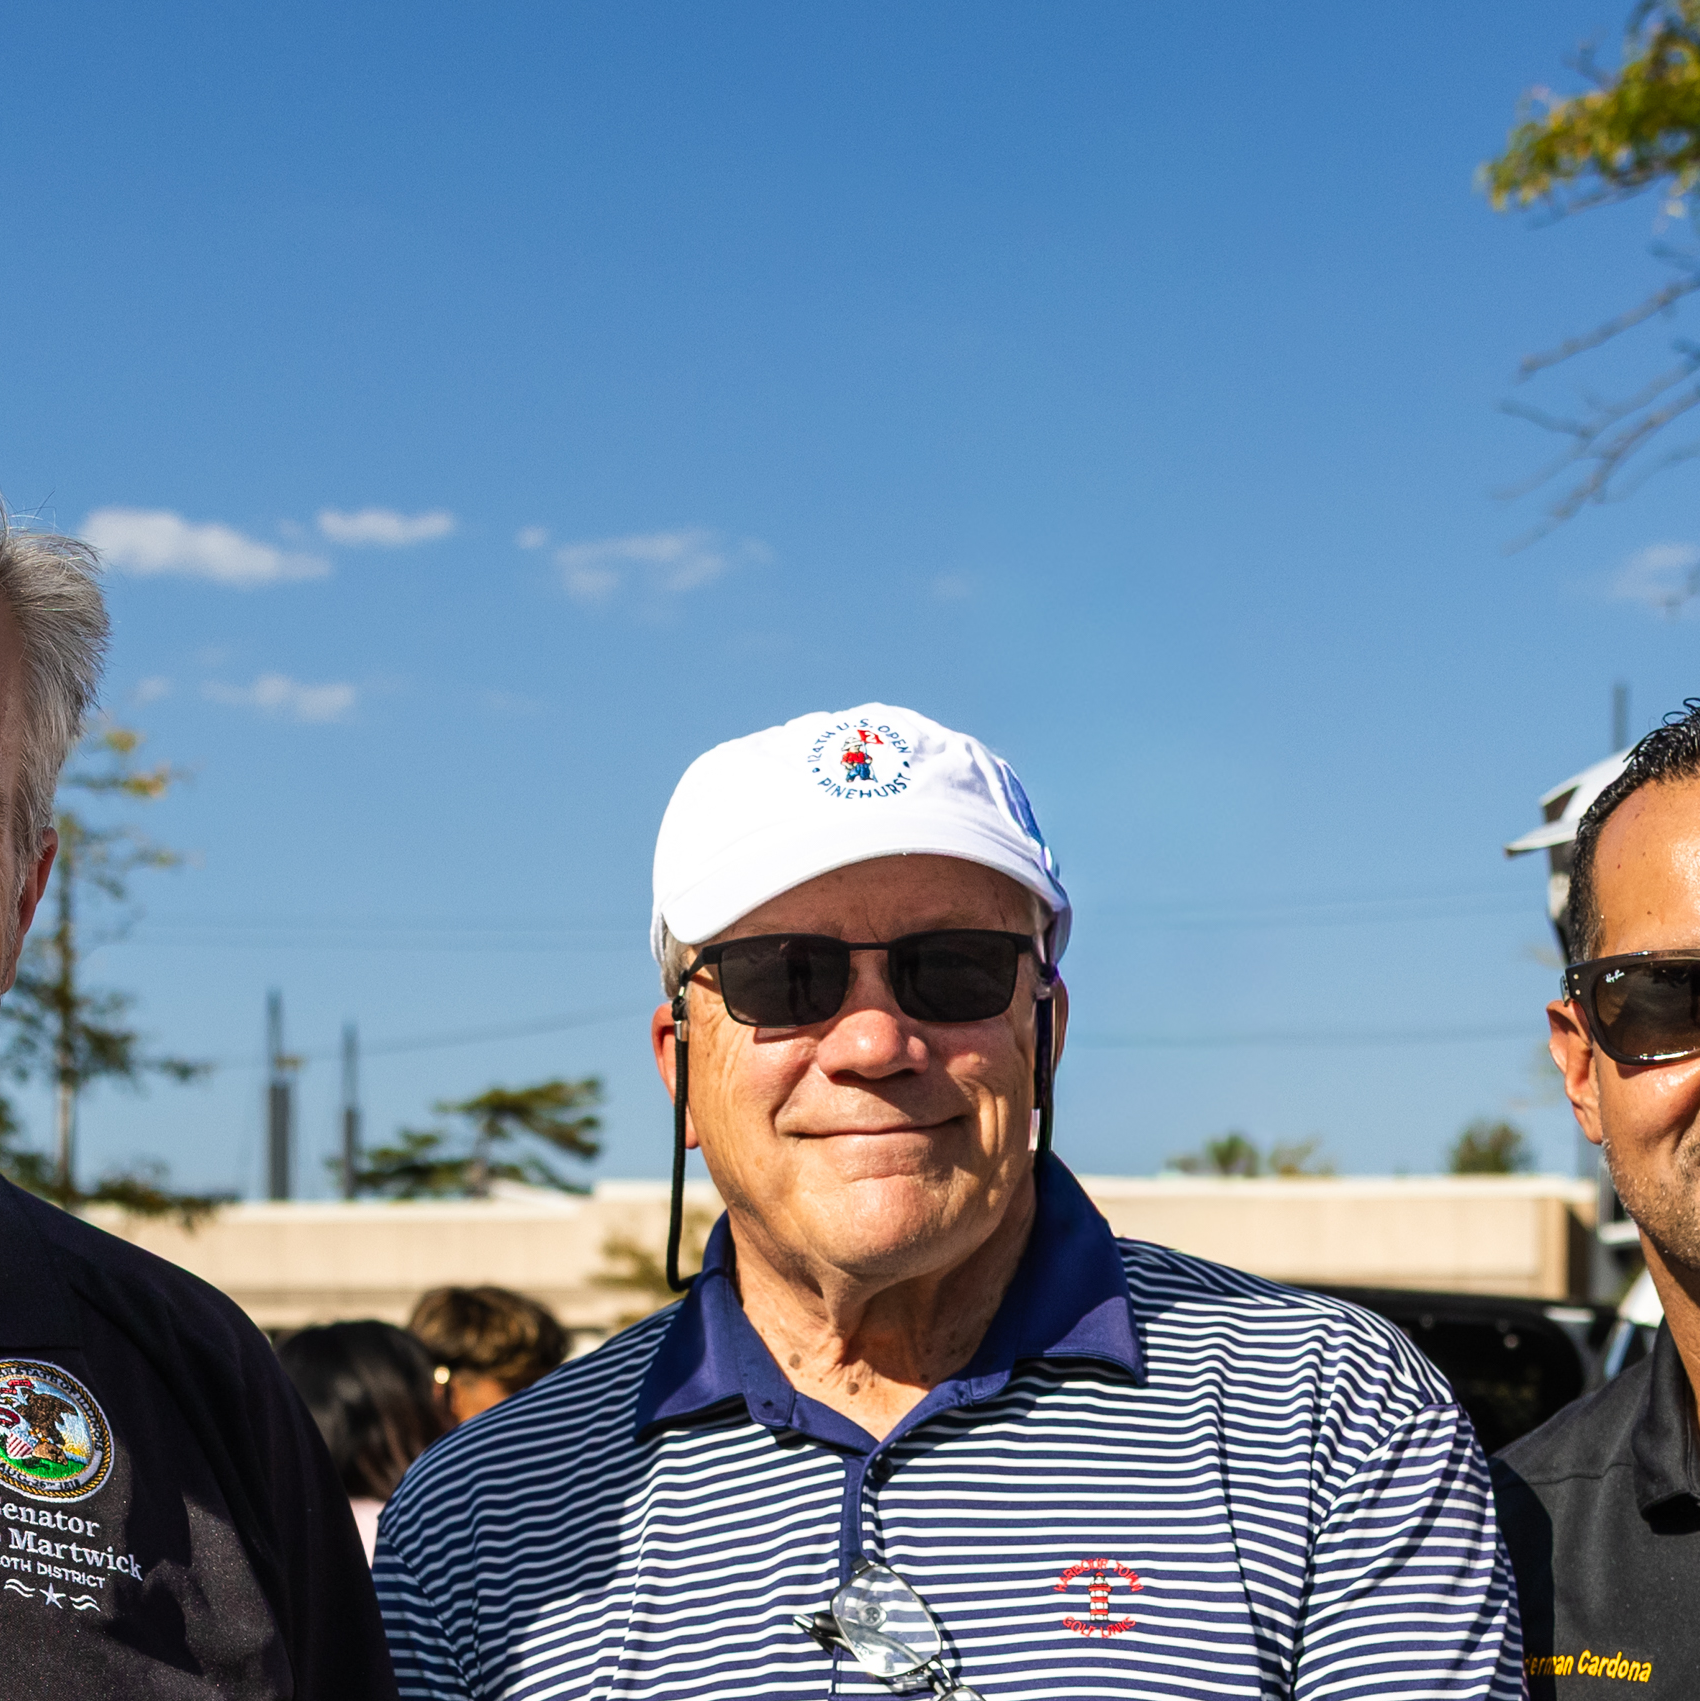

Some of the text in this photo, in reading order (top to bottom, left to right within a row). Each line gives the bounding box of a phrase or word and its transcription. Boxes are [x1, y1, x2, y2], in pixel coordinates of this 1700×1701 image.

[807, 718, 912, 763] 124TH U.S. OPEN
[817, 772, 911, 800] PINEHURST
[7, 1527, 144, 1582] Martwick
[36, 1561, 106, 1589] DISTRICT
[1053, 1558, 1144, 1593] HARBOUR TOWN
[1062, 1616, 1137, 1639] GOLF LINKS
[1577, 1649, 1652, 1683] Cardona
